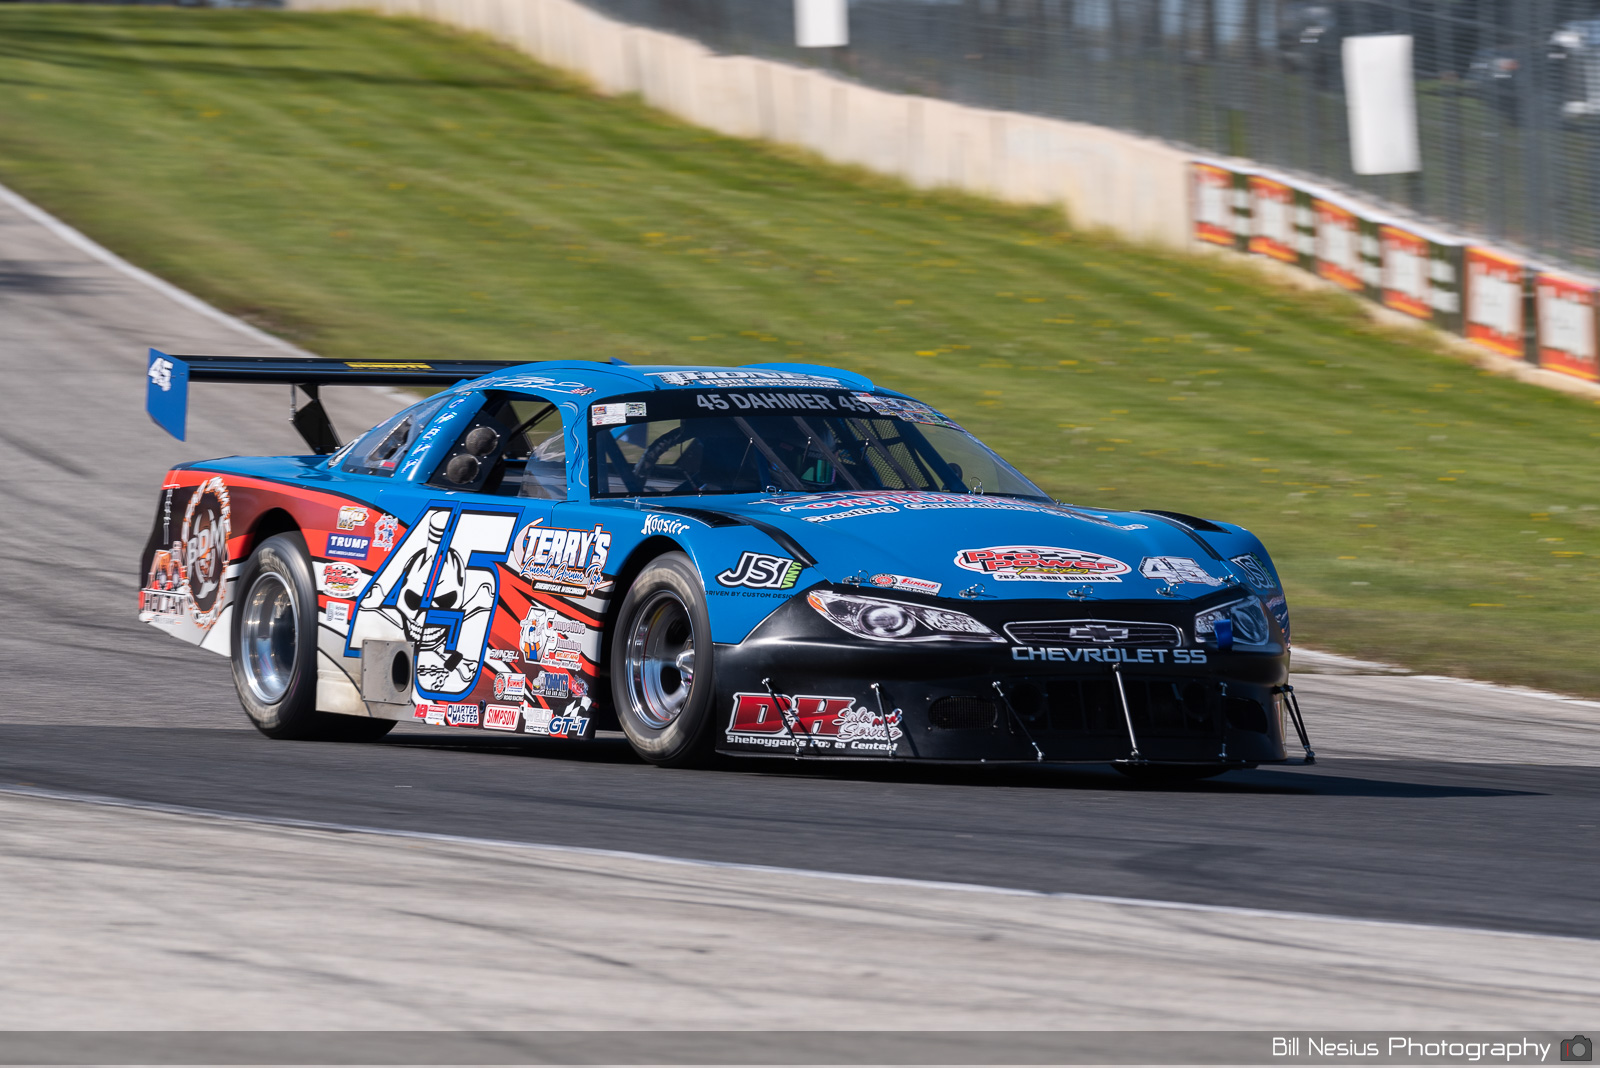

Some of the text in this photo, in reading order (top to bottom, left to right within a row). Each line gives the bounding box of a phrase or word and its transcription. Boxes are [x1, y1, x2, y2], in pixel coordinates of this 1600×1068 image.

[149, 357, 173, 391] 45
[696, 393, 872, 412] 45 DAHMER 45
[802, 506, 900, 523] Creating
[641, 514, 690, 536] Hoosier
[330, 535, 369, 549] TRUMP
[523, 525, 612, 571] TERRY'S
[964, 551, 1040, 563] Pro
[323, 565, 343, 576] Pro
[520, 556, 551, 577] Lincoln
[553, 561, 583, 582] Avenue
[716, 551, 793, 588] JSI
[1138, 556, 1221, 586] 45
[344, 499, 525, 701] 45
[544, 610, 586, 635] Competitive
[490, 649, 519, 659] SWINDELL
[544, 634, 581, 657] Plumbing
[1012, 646, 1207, 664] CHEVROLET SS
[448, 705, 478, 717] QUARTER
[452, 713, 478, 724] MASTER
[486, 708, 517, 726] SIMPSON
[527, 708, 552, 723] WELD
[832, 707, 875, 725] Sales
[549, 717, 589, 735] GT-1
